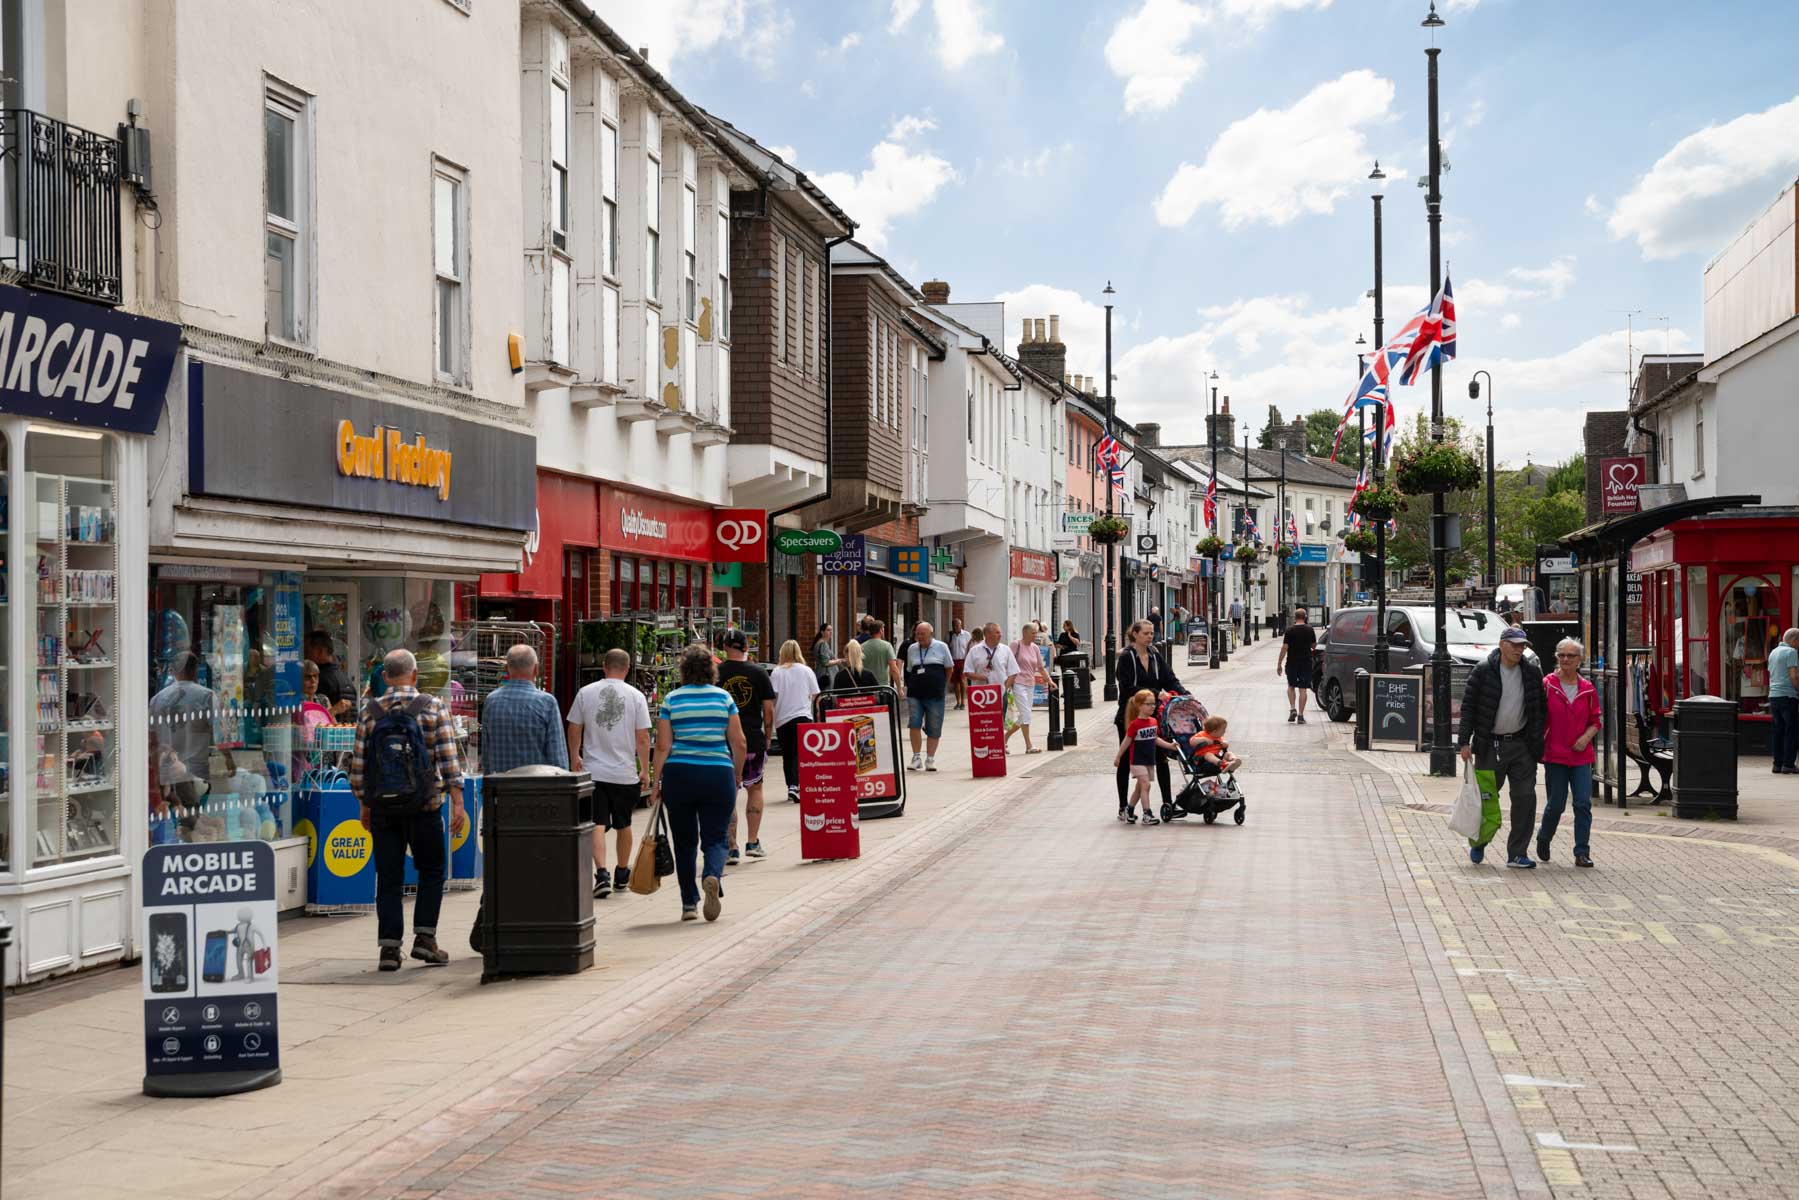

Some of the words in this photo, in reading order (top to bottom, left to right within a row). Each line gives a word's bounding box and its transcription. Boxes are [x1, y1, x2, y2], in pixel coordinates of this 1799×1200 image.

[337, 420, 384, 479] Card
[386, 429, 452, 501] Factory
[621, 507, 667, 541] QualityDiscounts.com
[716, 520, 761, 551] QD
[780, 537, 834, 548] Specsavers
[367, 623, 401, 641] YOU
[1388, 683, 1408, 694] BHF
[971, 689, 998, 709] QD
[803, 729, 841, 757] QD
[822, 785, 841, 793] Collect
[857, 780, 886, 797] .99
[805, 818, 824, 826] happy
[826, 817, 846, 825] prices
[332, 837, 366, 848] GREAT
[162, 851, 254, 873] MOBILE
[332, 848, 366, 859] VALUE
[161, 873, 256, 896] ARCADE
